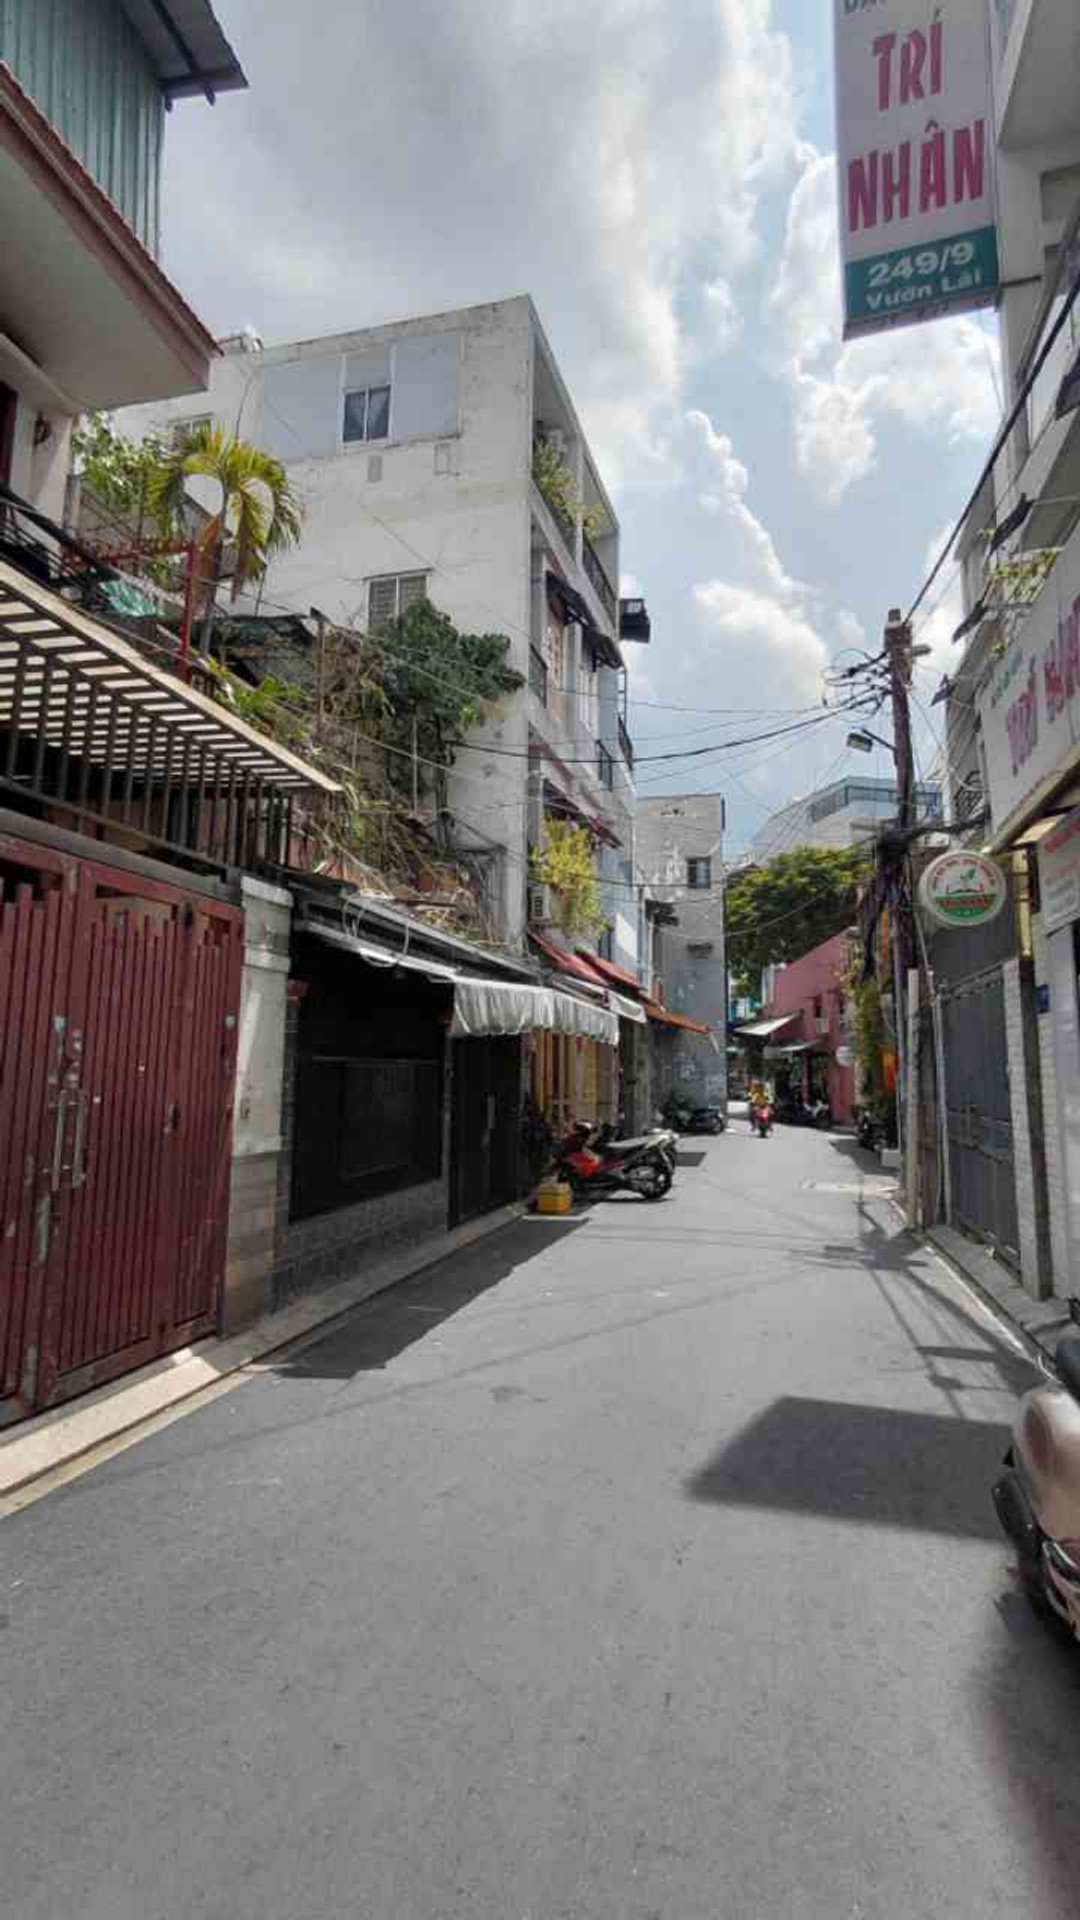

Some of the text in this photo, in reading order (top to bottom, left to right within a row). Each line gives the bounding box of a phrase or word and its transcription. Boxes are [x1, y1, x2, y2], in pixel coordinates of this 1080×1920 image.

[873, 8, 942, 112] TRÍ
[848, 118, 985, 232] NHÂN
[867, 241, 974, 288] 249/9
